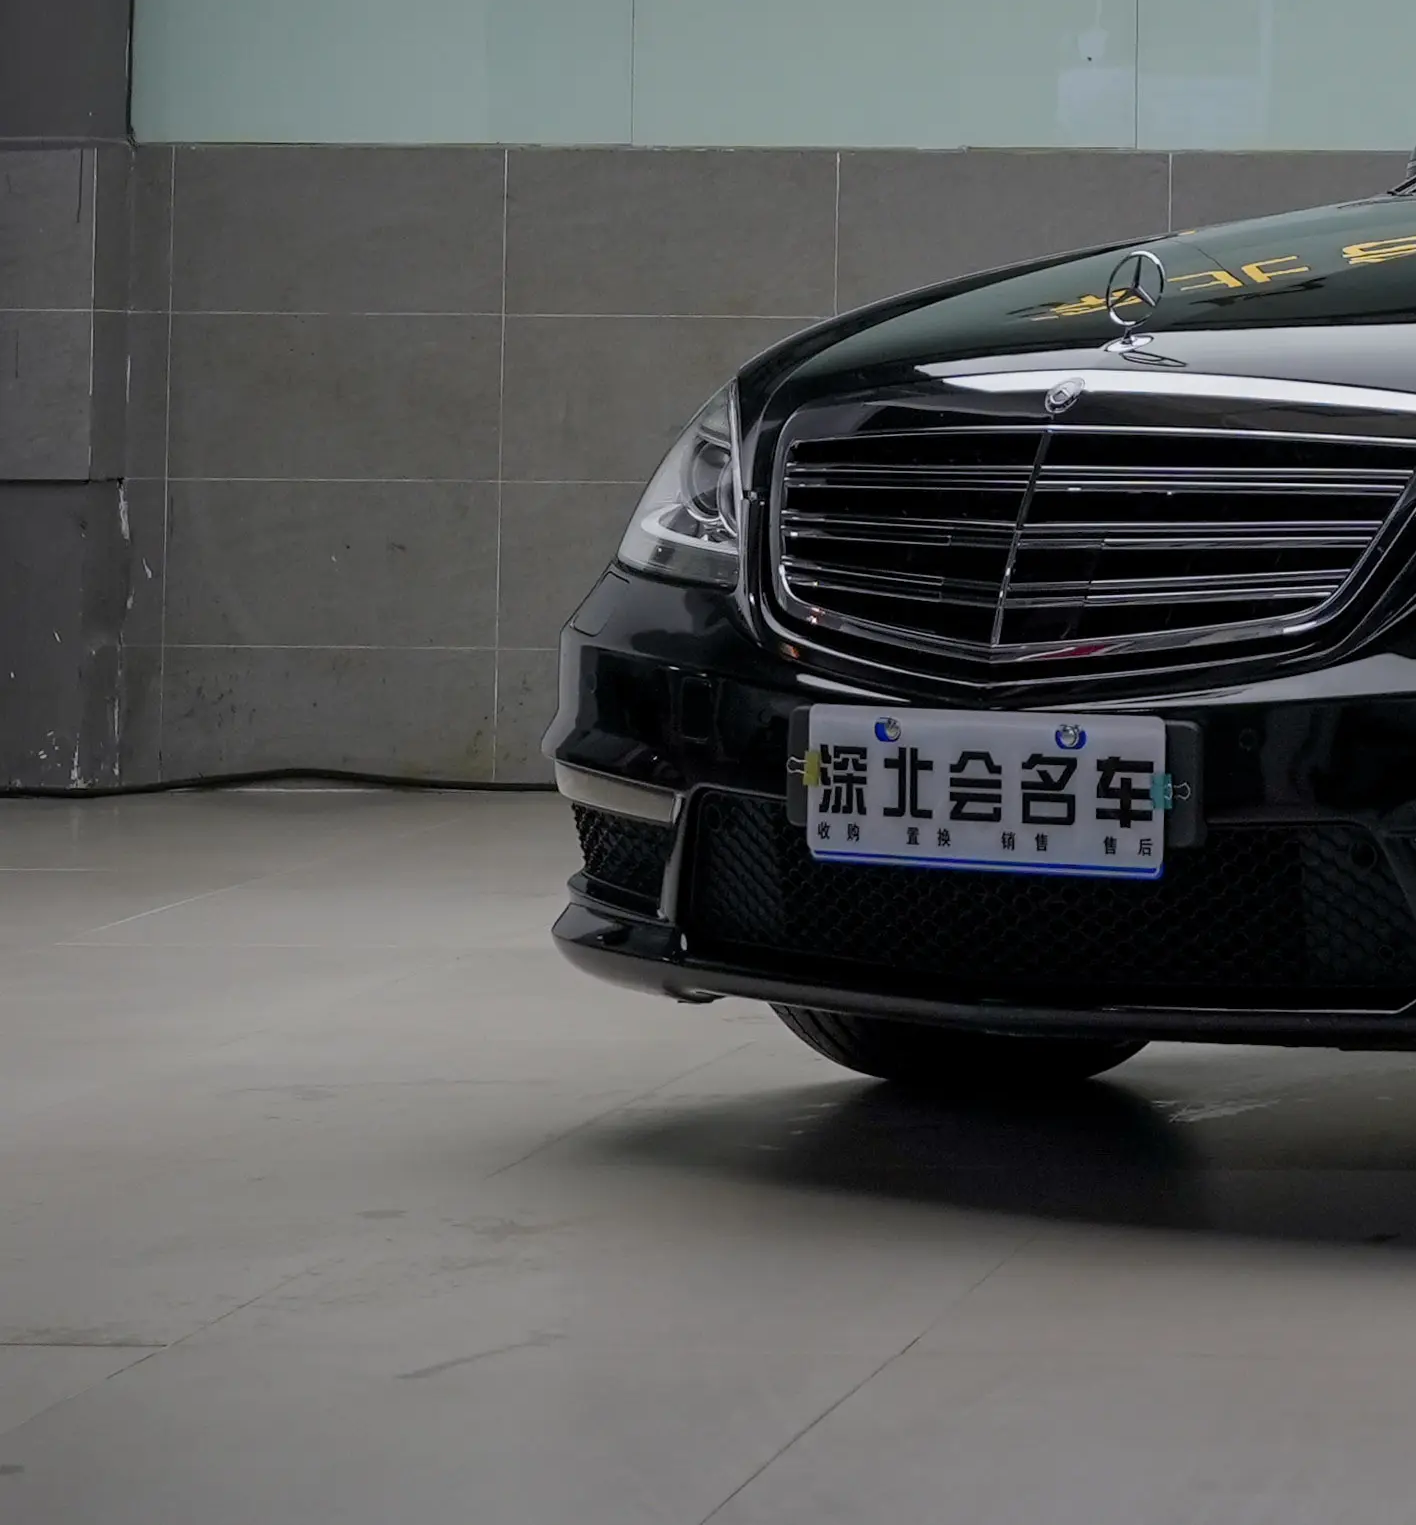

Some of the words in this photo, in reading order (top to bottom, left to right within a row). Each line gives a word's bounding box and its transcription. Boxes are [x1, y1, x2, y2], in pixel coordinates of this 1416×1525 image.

[818, 743, 1155, 829] 深北会名车
[817, 821, 861, 844] 收购
[905, 826, 952, 848] 置换
[1000, 831, 1049, 853] 销售
[1103, 835, 1153, 857] 售后
